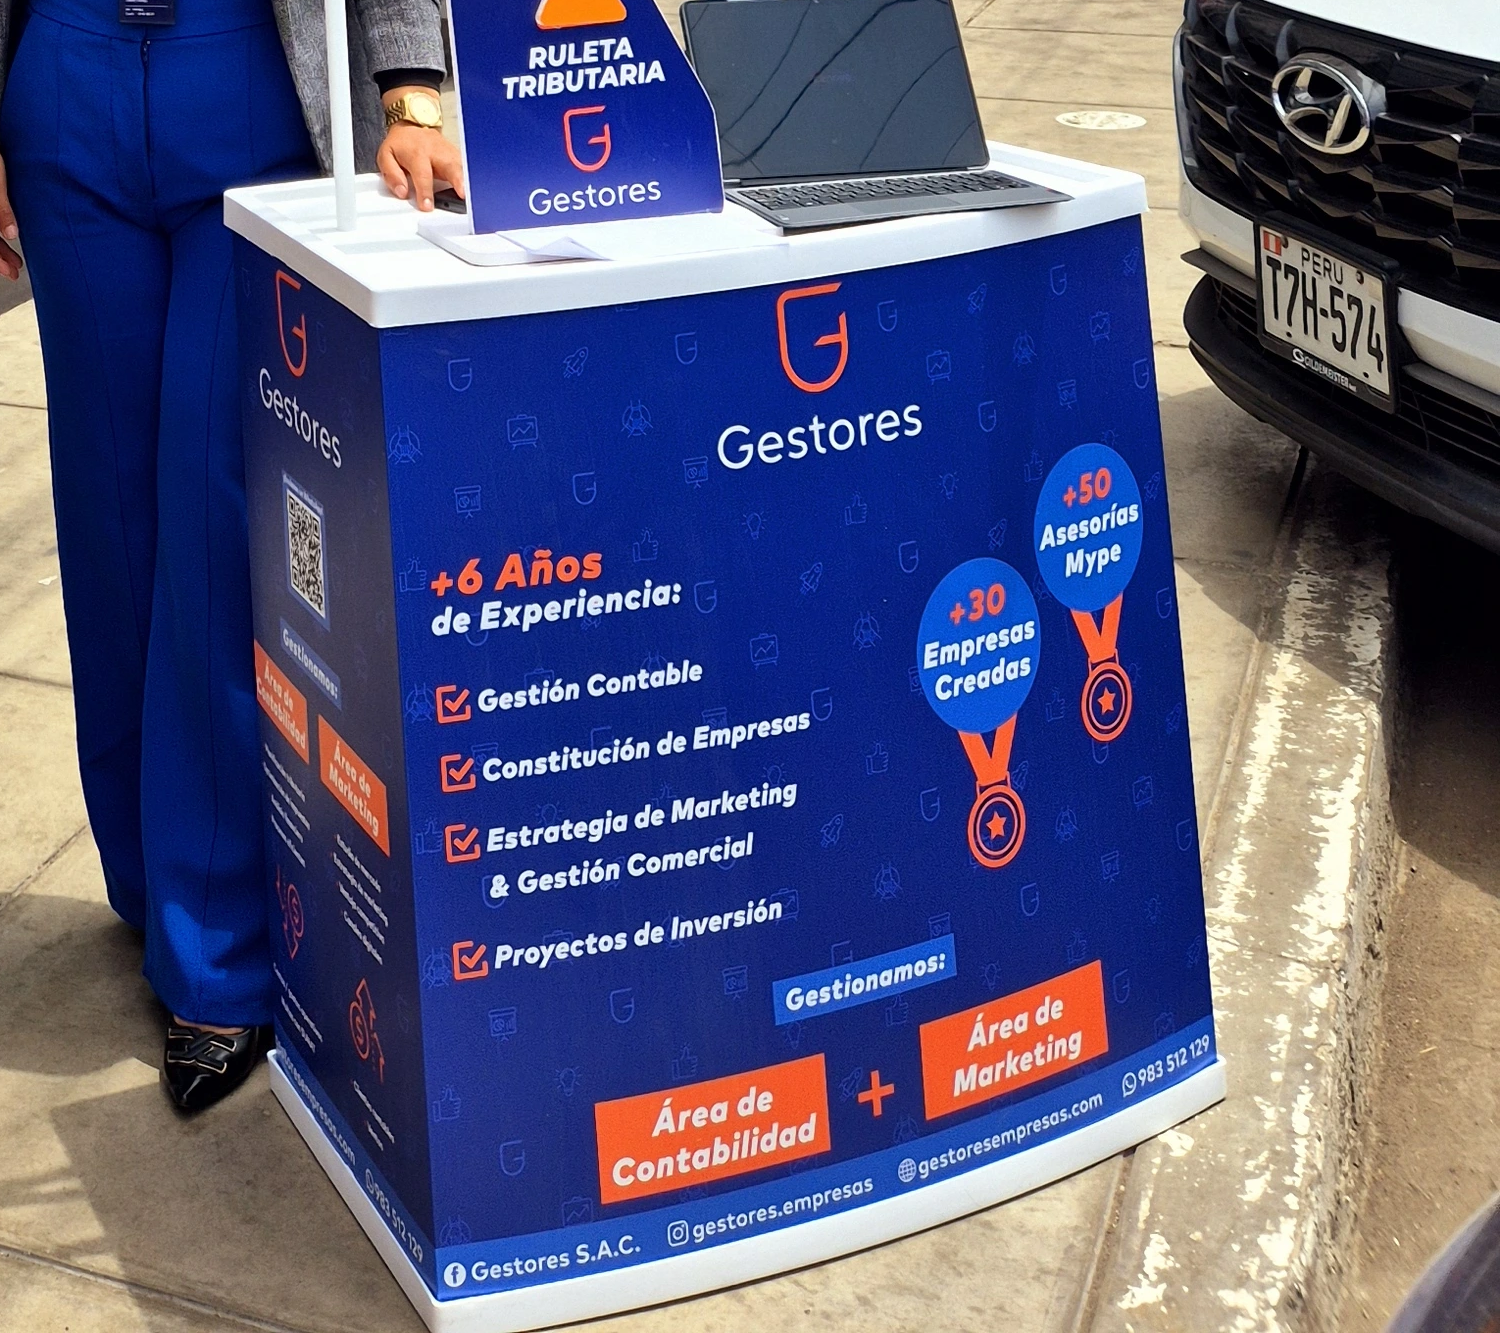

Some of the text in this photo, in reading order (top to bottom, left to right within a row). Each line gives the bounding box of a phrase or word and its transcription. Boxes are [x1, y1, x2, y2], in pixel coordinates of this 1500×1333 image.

[502, 60, 666, 100] TRIBUTARIA
[529, 36, 634, 70] RULETA
[528, 180, 662, 216] Gestores
[1301, 247, 1344, 285] PERU
[1266, 256, 1384, 373] T7H-574
[258, 367, 342, 470] Gestores
[717, 401, 923, 471] Gestores
[1063, 467, 1111, 509] +50
[1039, 499, 1140, 552] Asesorías
[430, 548, 603, 598] +6 Años
[1064, 541, 1122, 579] Mype
[431, 581, 683, 637] de Experiencia:
[949, 583, 1006, 626] +30
[923, 617, 1035, 669] Empresas
[477, 659, 703, 714] Gestión Contable
[934, 654, 1032, 702] Creadas
[334, 740, 371, 799] Área de
[481, 709, 811, 783] Constitución de Empresas
[329, 763, 379, 837] Marketing
[486, 780, 798, 855] Estrategia de Marketing
[488, 832, 754, 899] & Gestión Comercial
[494, 898, 783, 971] Proyectos de Inversión
[786, 952, 947, 1012] Gestionamos:
[966, 995, 1065, 1053] Área de
[952, 1030, 1083, 1097] Marketing
[1137, 1034, 1210, 1089] 983 512 129
[652, 1087, 774, 1138] Área de
[918, 1091, 1103, 1180] gestoresempresas.com
[612, 1114, 818, 1188] Contabilidad
[692, 1175, 874, 1244] gestores.empresas
[470, 1237, 641, 1282] Gestores S.A.C.
